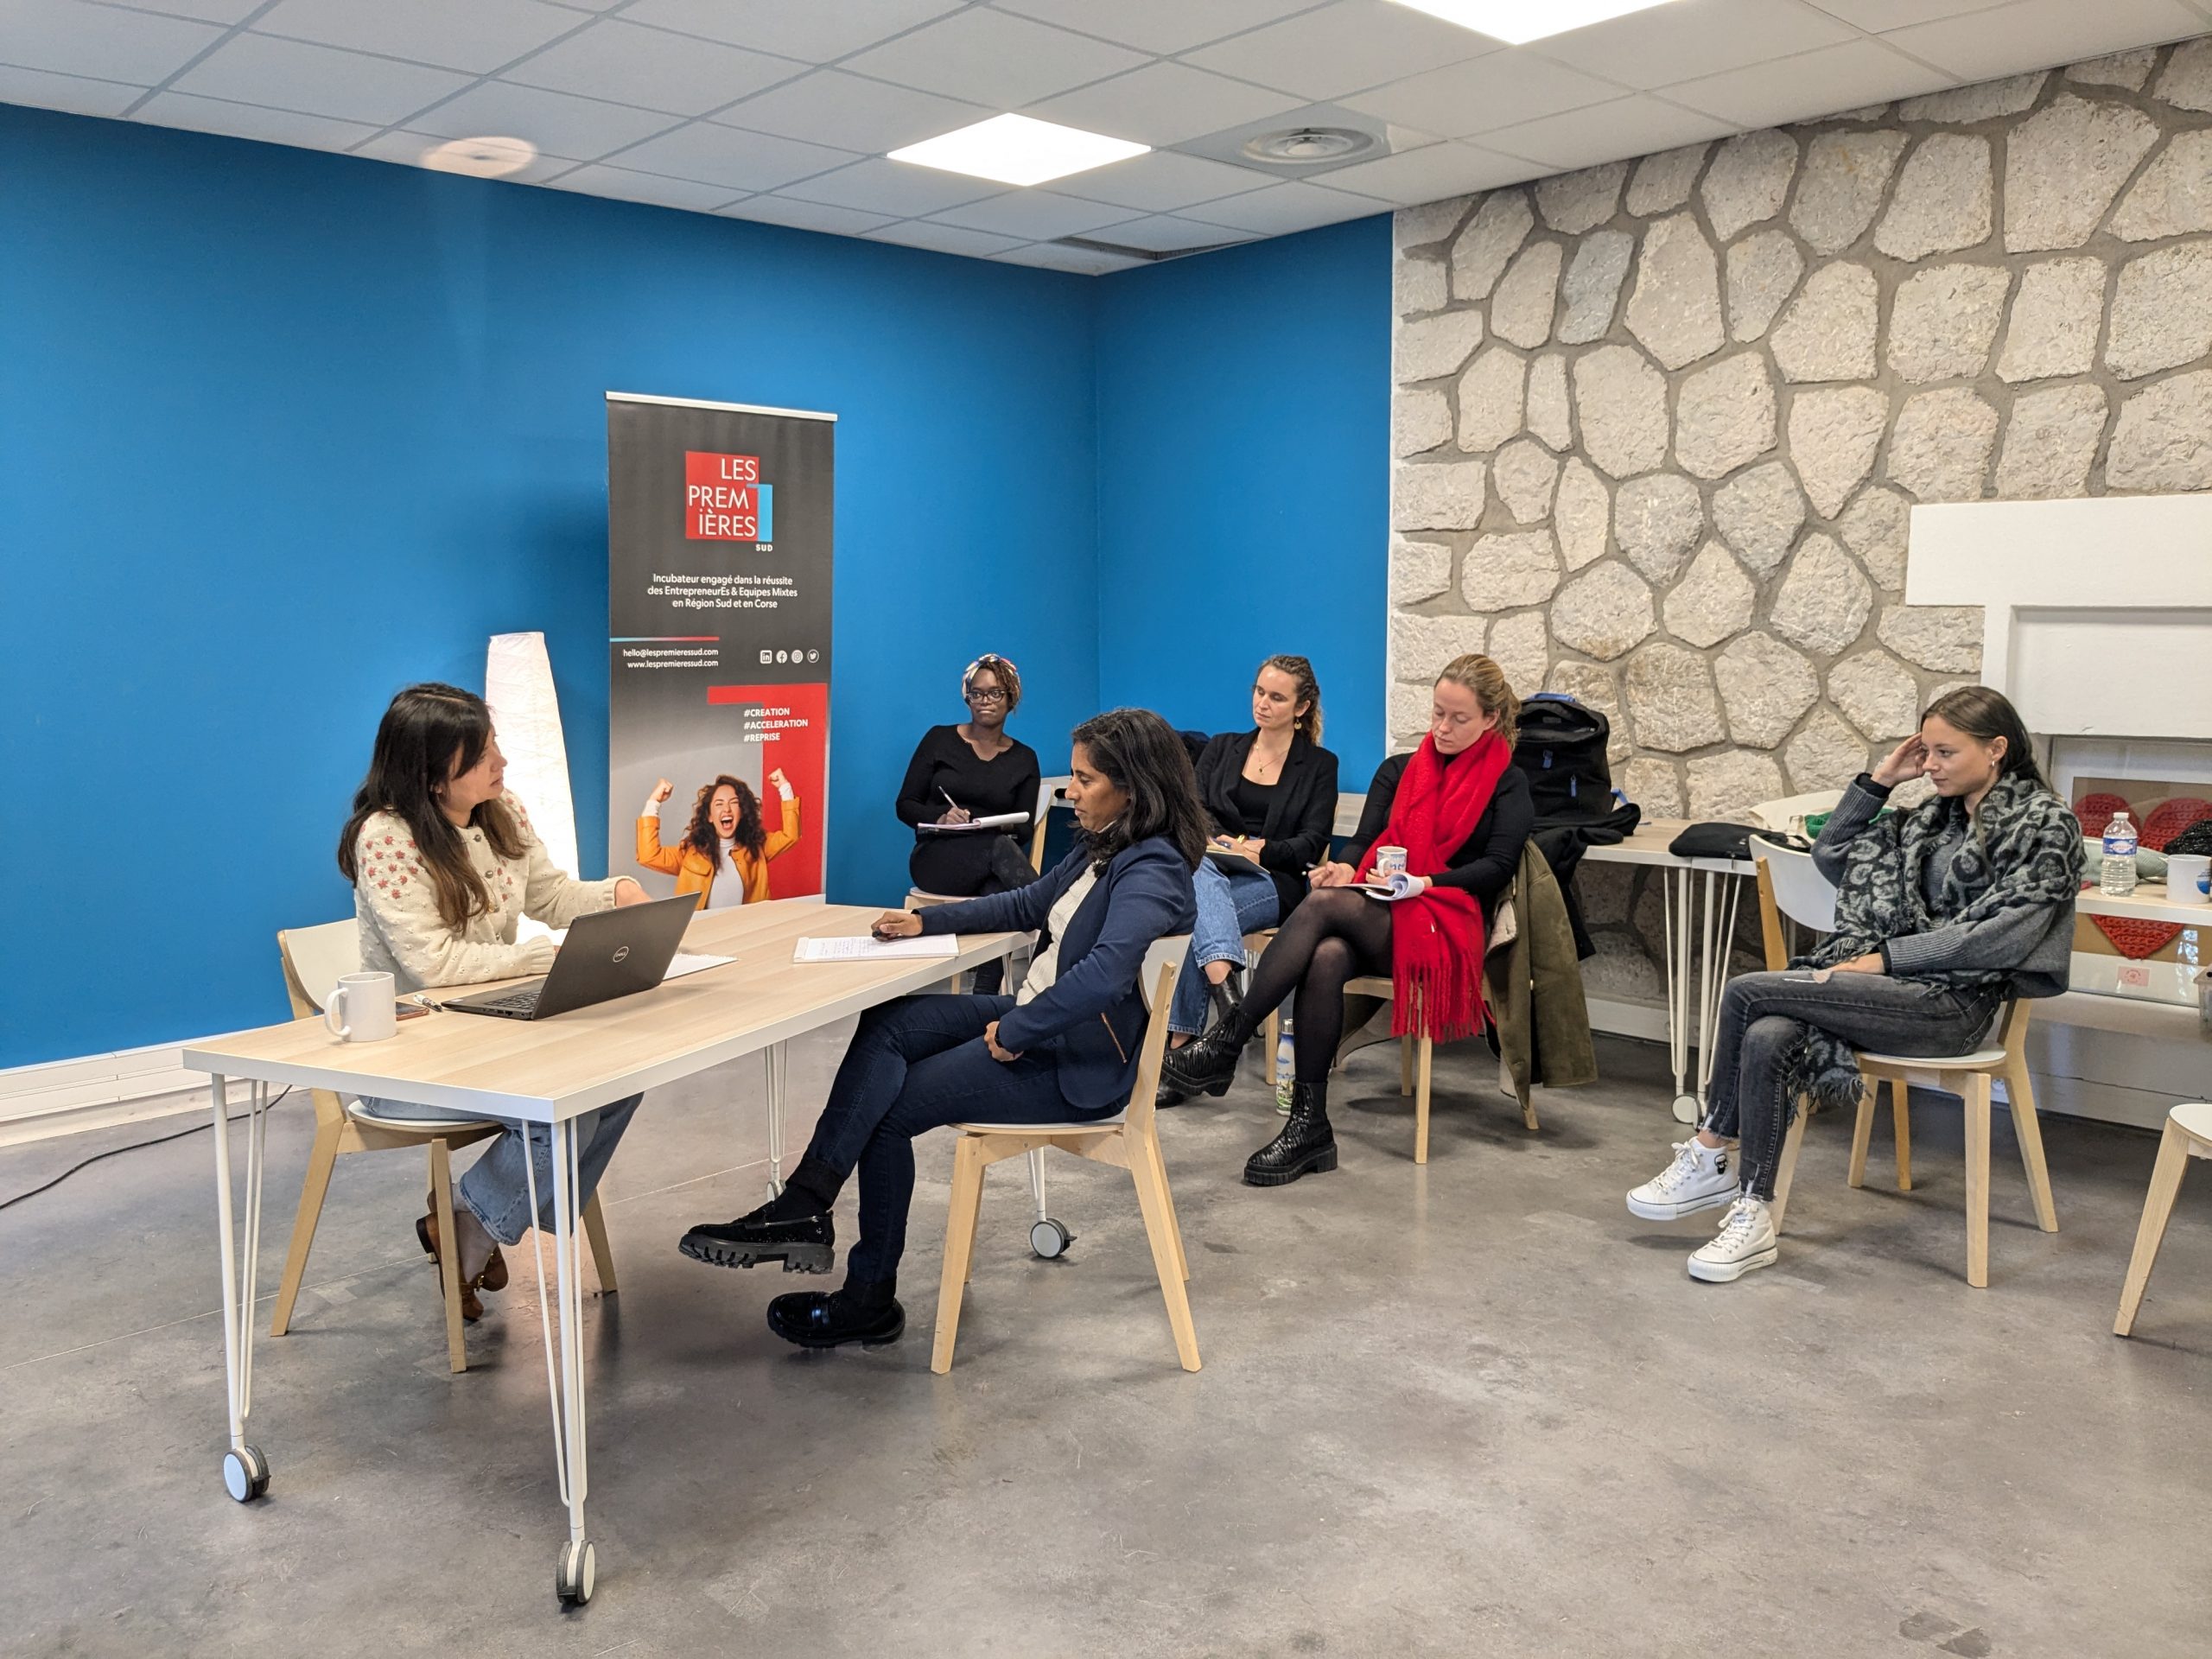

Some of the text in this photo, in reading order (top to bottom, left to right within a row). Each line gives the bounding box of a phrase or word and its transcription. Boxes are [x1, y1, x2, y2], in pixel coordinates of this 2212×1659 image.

[721, 458, 756, 481] LES
[689, 485, 749, 509] PREM
[755, 543, 773, 552] SUD
[653, 574, 699, 583] Incubateur
[701, 575, 733, 586] engagé
[734, 575, 753, 584] dans
[753, 575, 761, 584] la
[647, 587, 664, 595] des
[664, 586, 730, 596] EntrepreneurEs
[739, 588, 771, 598] Equipes
[772, 588, 798, 597] Mixtes
[685, 598, 715, 609] Région
[715, 599, 732, 607] Sud
[754, 600, 778, 608] Corse
[623, 648, 719, 658] hello@lespremieressud.com
[627, 659, 719, 669] www.lespremieressud.com
[744, 708, 791, 717] #CREATION
[744, 719, 809, 729] #ACCELERATION
[744, 733, 780, 741] #REPRISE
